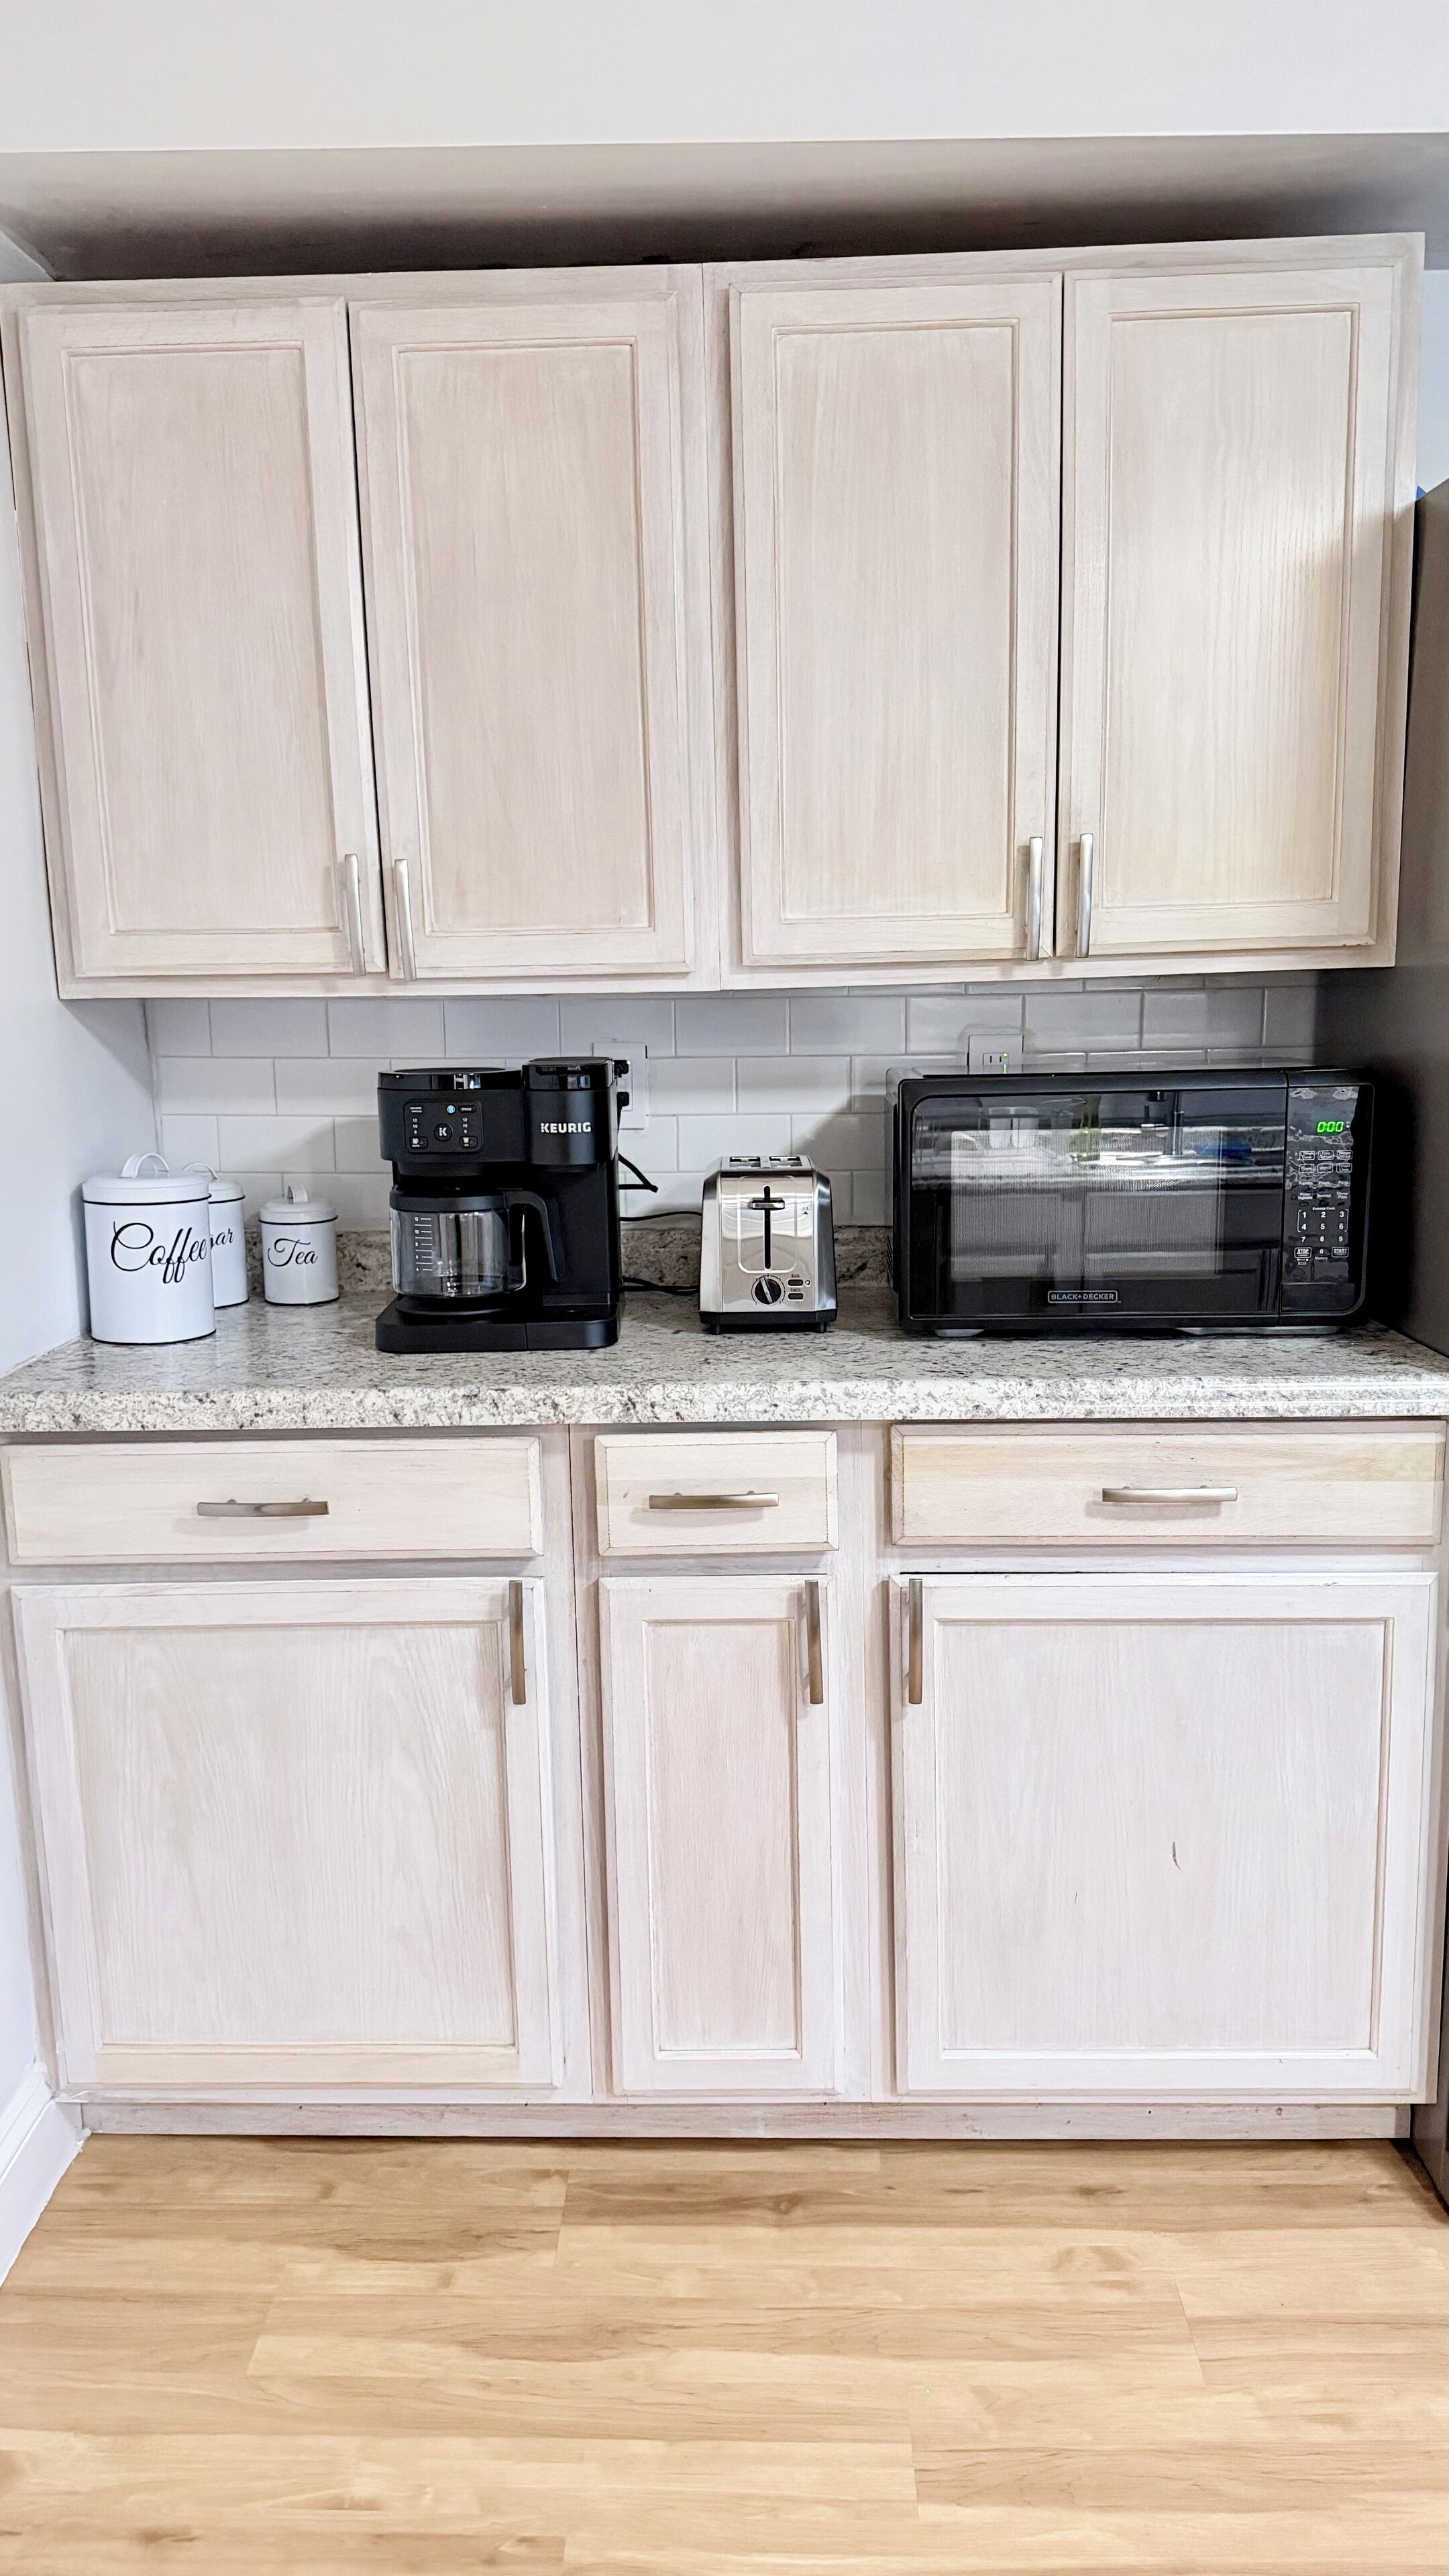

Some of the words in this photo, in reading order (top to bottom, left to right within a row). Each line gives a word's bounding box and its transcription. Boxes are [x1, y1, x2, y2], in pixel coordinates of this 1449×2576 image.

[439, 1127, 447, 1136] K
[540, 1122, 592, 1134] KEURIG
[1317, 1121, 1344, 1133] 0:00
[111, 1220, 207, 1284] Coffee
[268, 1238, 319, 1267] Tea
